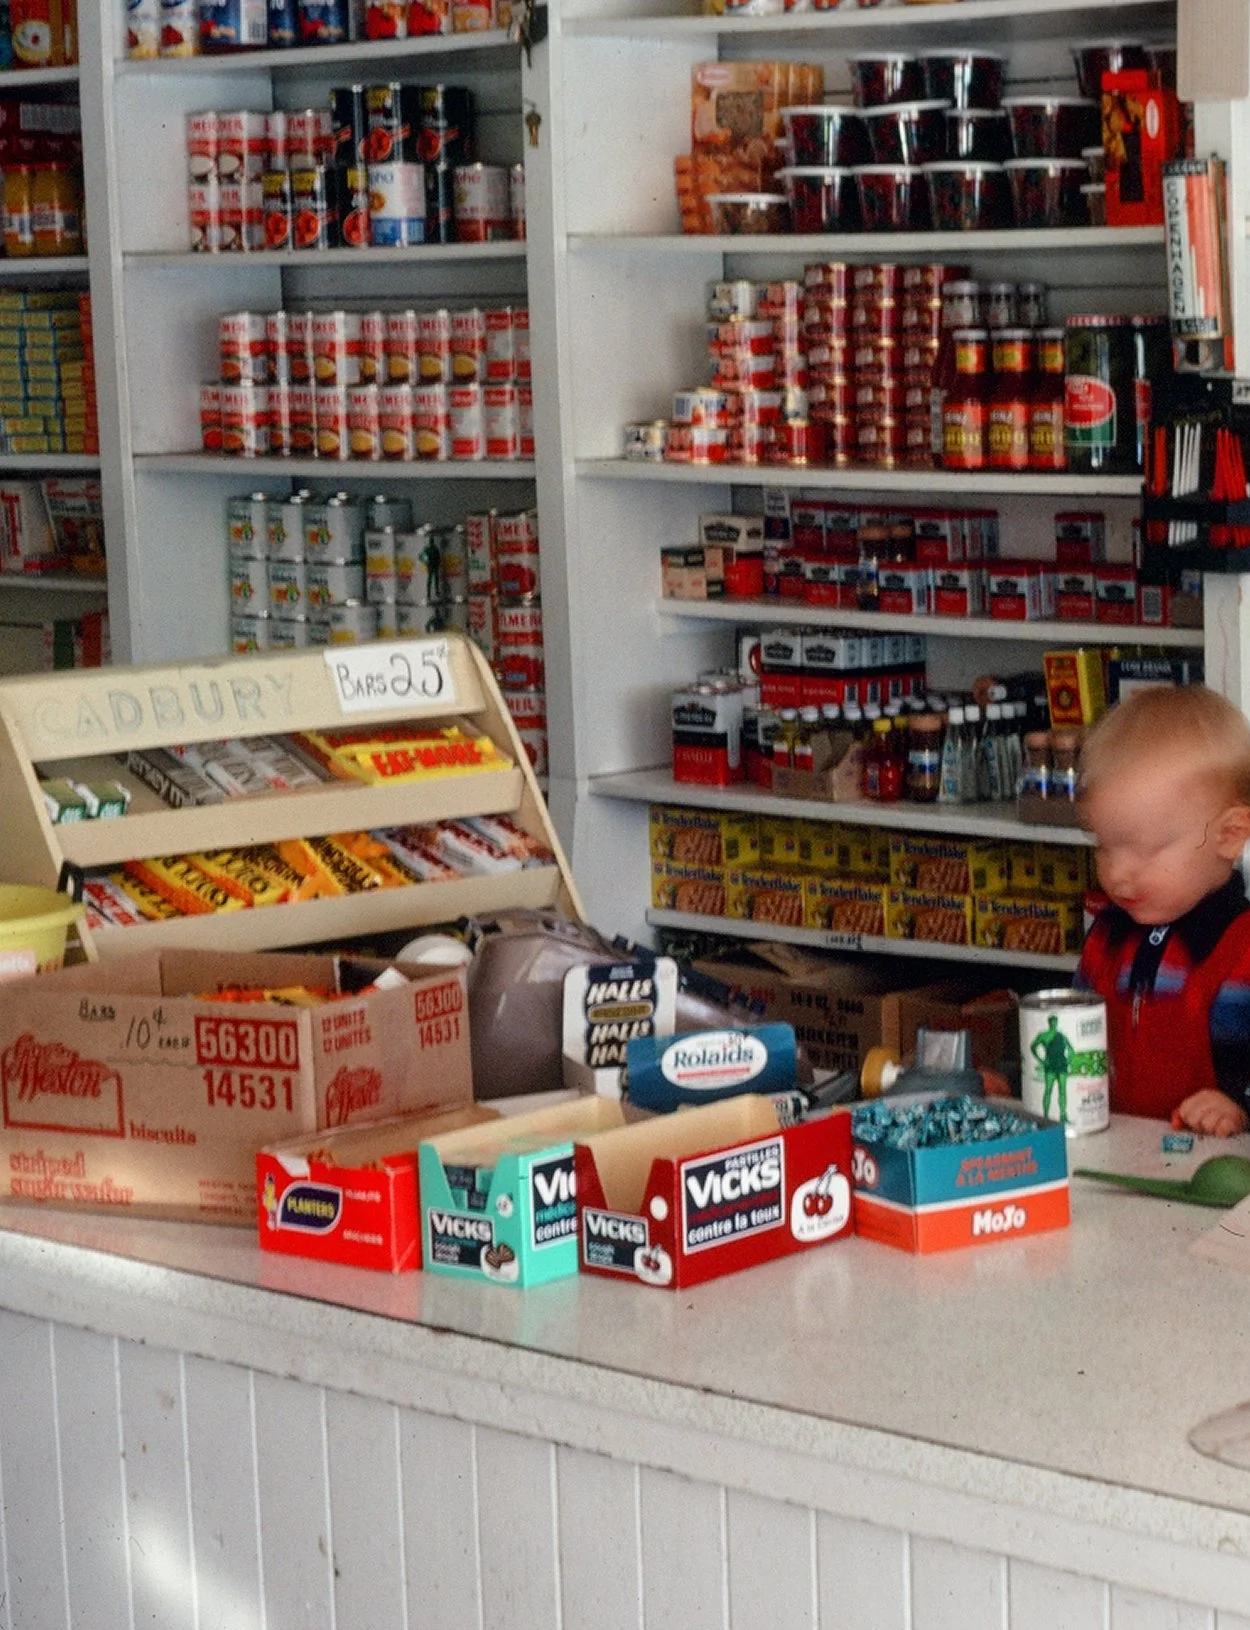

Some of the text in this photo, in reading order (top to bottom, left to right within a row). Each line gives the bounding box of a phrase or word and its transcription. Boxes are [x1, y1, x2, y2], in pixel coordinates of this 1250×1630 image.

[1165, 179, 1186, 316] COPENHAGEN
[33, 673, 298, 744] CADBURY
[371, 740, 482, 778] EAT-MORE
[417, 984, 462, 1022] 56300
[587, 979, 653, 1005] HALLS
[200, 1021, 298, 1066] 56300
[418, 1017, 461, 1050] 14531
[589, 1020, 651, 1045] HALLS
[673, 1043, 754, 1069] Rolaids
[10, 1057, 103, 1103] Weston
[202, 1069, 295, 1112] 14531
[130, 1120, 197, 1146] biscuits
[9, 1149, 86, 1180] striped
[725, 1146, 779, 1172] PASTILLES
[962, 1148, 1033, 1172] SPEARMINT
[987, 1161, 1039, 1181] MENTHE
[10, 1177, 135, 1206] sugar wafer
[286, 1197, 335, 1218] PLANTERS
[432, 1213, 492, 1243] VICKS
[586, 1214, 645, 1244] VICKS
[687, 1217, 733, 1245] contre
[734, 1212, 748, 1231] la
[750, 1204, 780, 1226] toux
